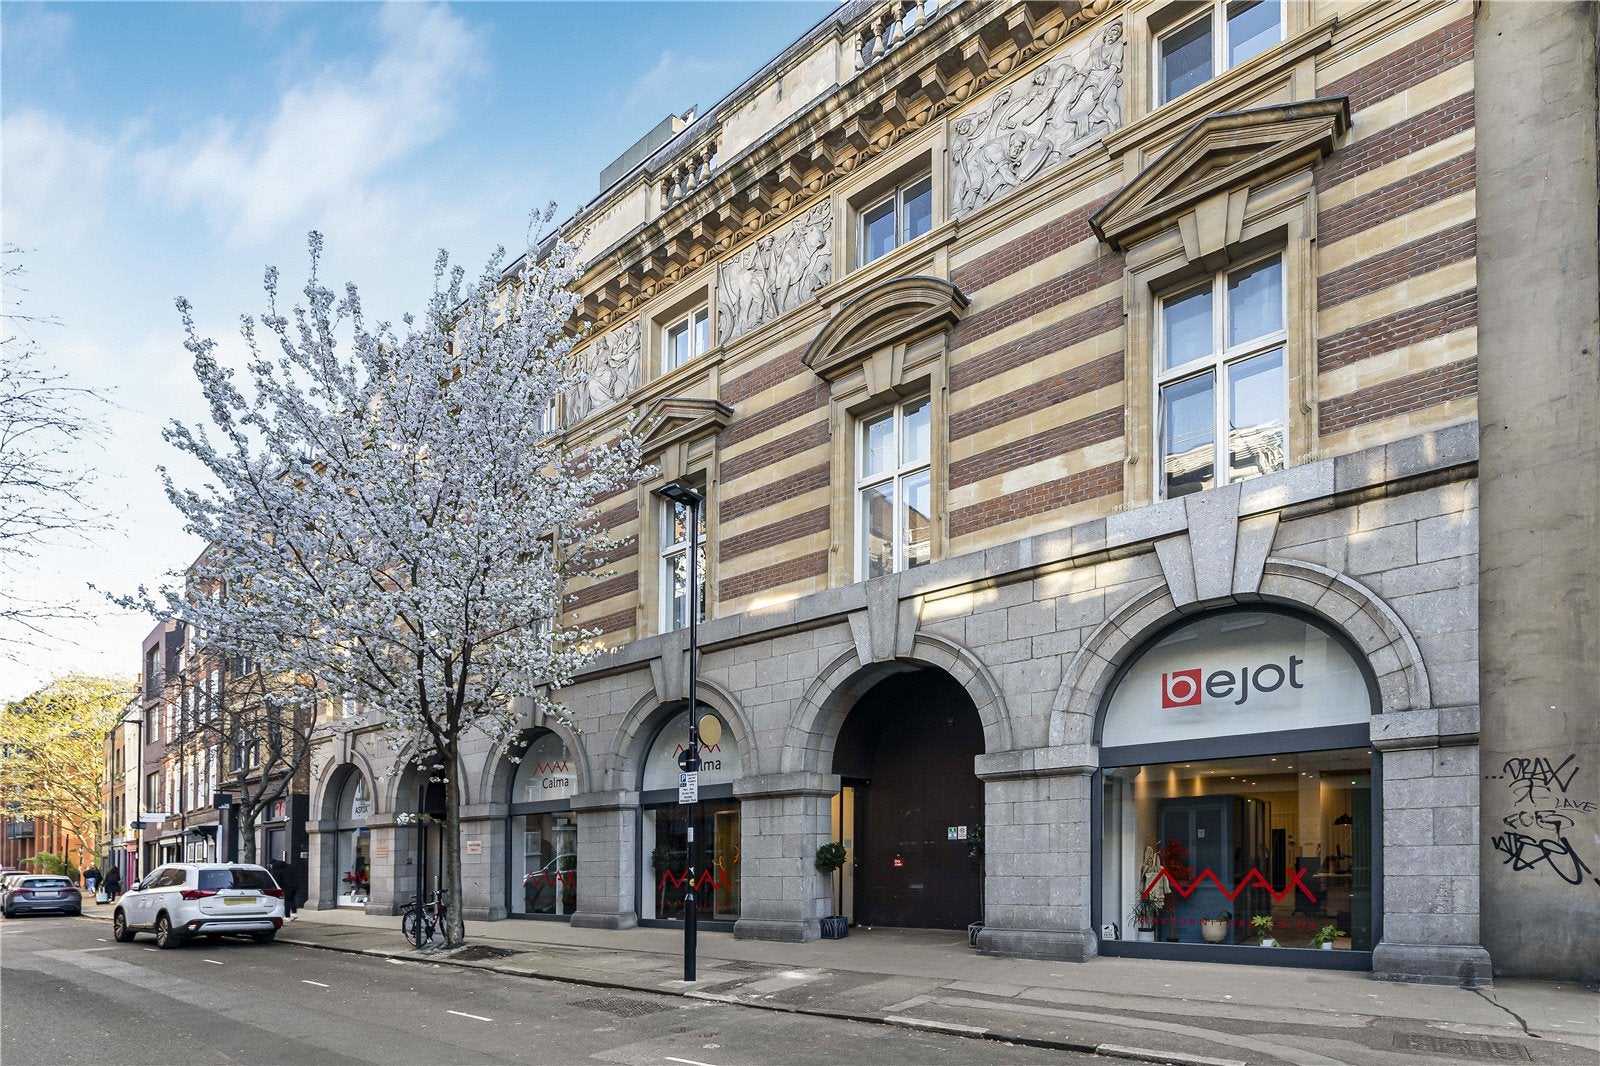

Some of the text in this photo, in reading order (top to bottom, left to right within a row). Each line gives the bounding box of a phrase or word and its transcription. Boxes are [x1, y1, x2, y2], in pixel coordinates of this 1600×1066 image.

[1162, 655, 1304, 709] bejot
[533, 760, 569, 776] MAX
[699, 759, 721, 771] lma
[542, 777, 569, 789] Calma
[1140, 867, 1317, 903] MAX
